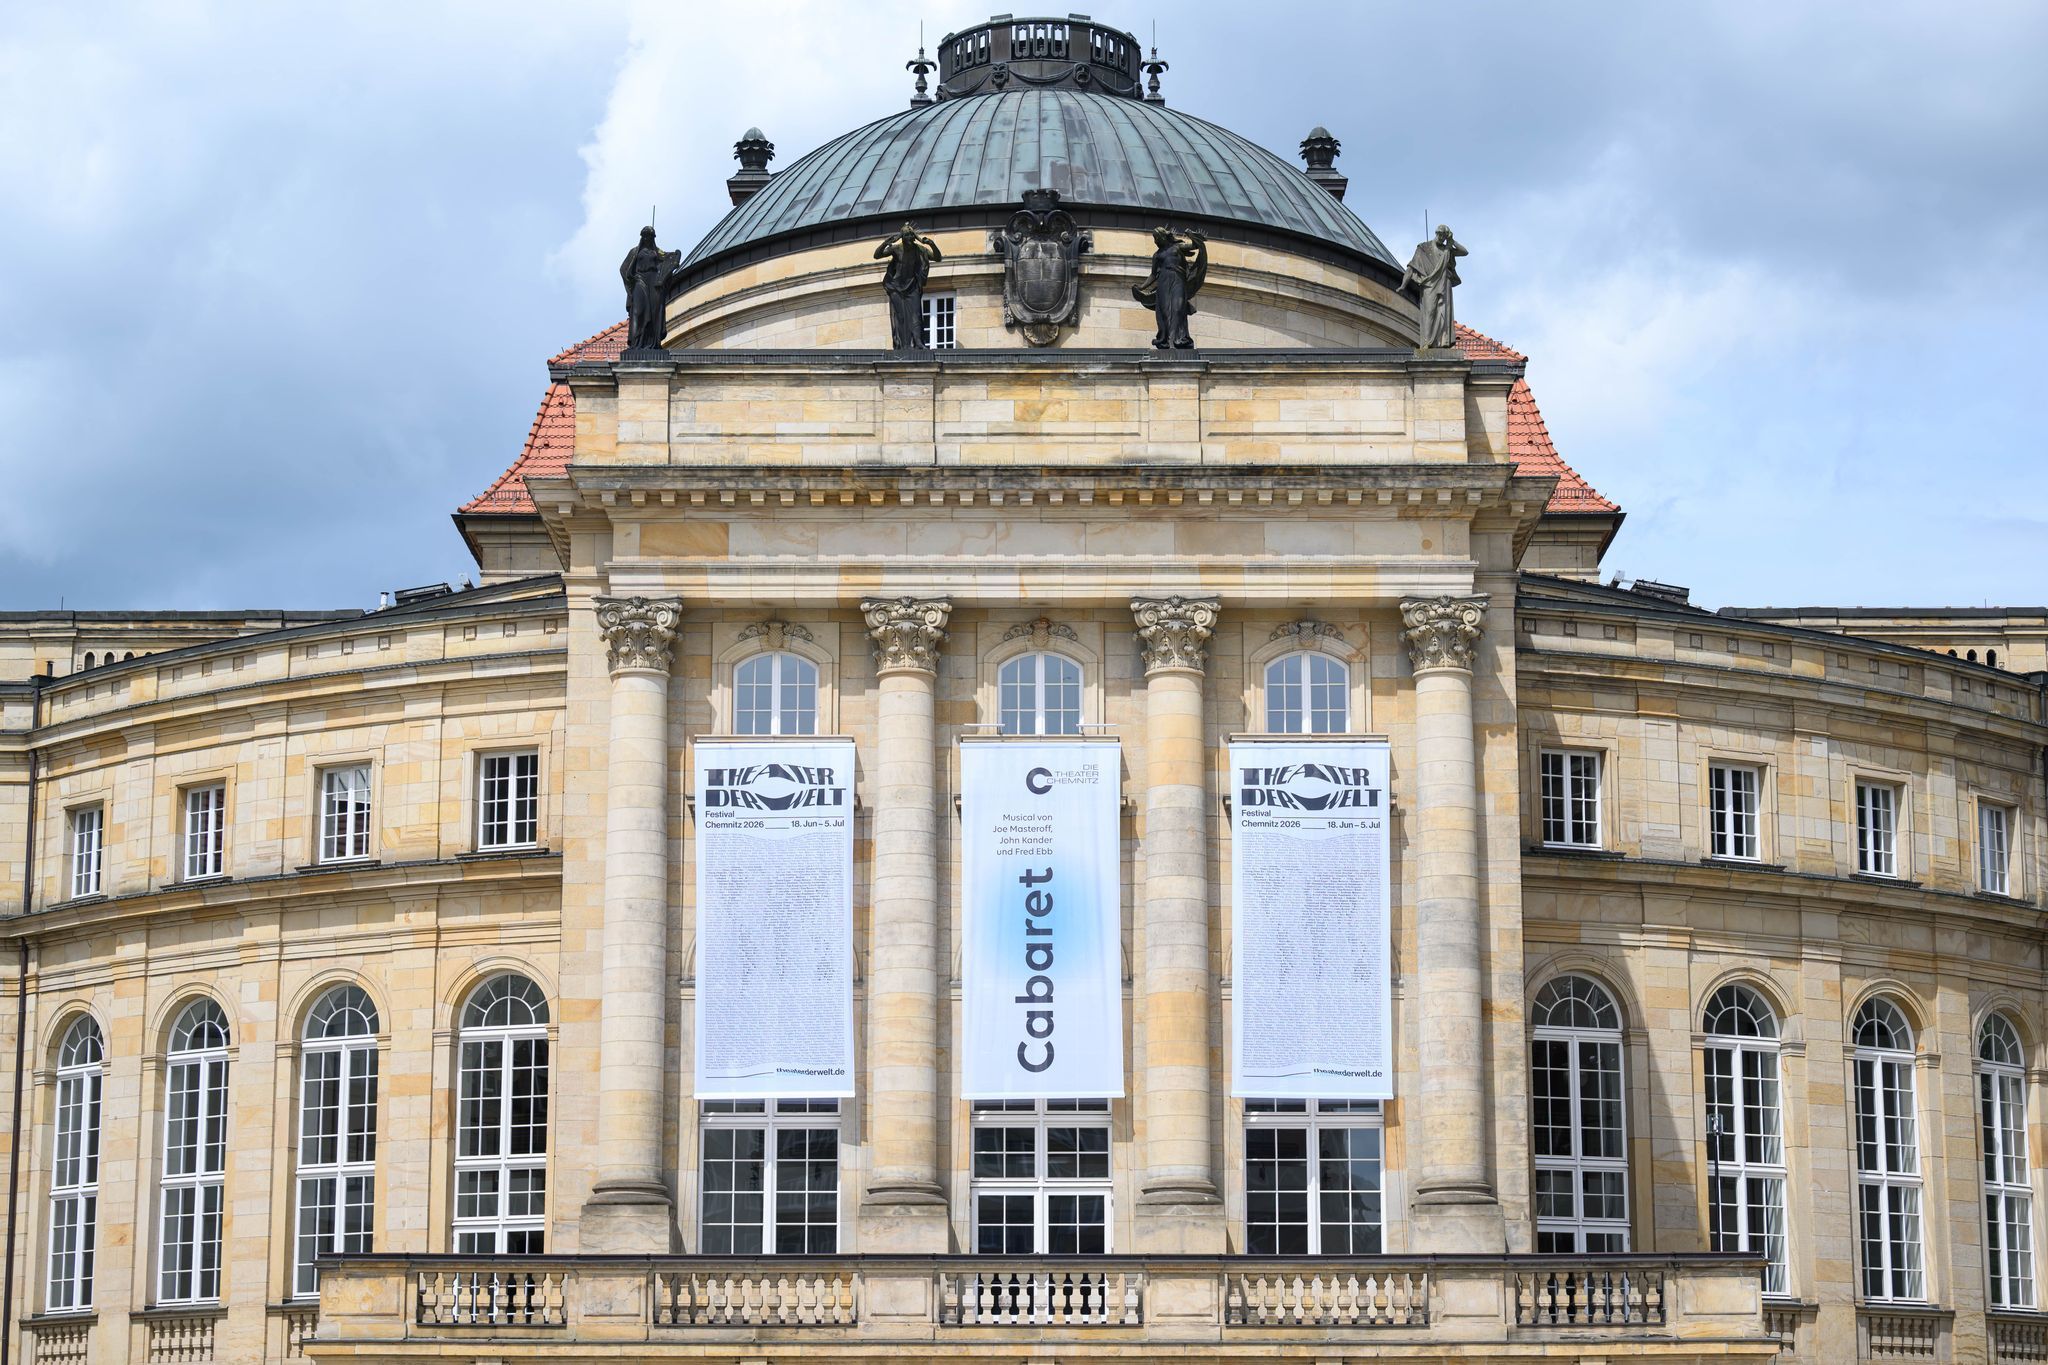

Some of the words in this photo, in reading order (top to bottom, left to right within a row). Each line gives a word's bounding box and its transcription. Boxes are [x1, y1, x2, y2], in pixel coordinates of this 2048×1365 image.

[704, 763, 834, 787] THEATER
[1054, 770, 1099, 778] THEATER
[1240, 763, 1370, 787] THEATER
[1046, 777, 1099, 785] CHEMNITZ
[705, 789, 764, 811] DER
[754, 788, 847, 811] WELT
[1241, 788, 1300, 810] DER
[1291, 789, 1382, 811] WELT
[705, 810, 735, 818] Festival
[1002, 813, 1036, 822] Musical
[1241, 809, 1271, 817] Festival
[705, 820, 743, 829] Chemnitz
[743, 821, 765, 829] 2026
[791, 820, 802, 828] 18.
[802, 819, 818, 828] Jun
[824, 819, 832, 827] 5.
[832, 819, 845, 827] Jul
[993, 825, 1008, 833] Joe
[1009, 824, 1053, 834] Masteroff,
[1241, 819, 1279, 828] Chemnitz
[1280, 820, 1301, 828] 2026
[1327, 821, 1338, 829] 18.
[1339, 821, 1354, 829] Jun
[1360, 821, 1368, 829] 5.
[1368, 821, 1381, 829] Jul
[999, 836, 1020, 845] John
[1021, 836, 1053, 844] Kander
[996, 847, 1013, 856] und
[1015, 848, 1034, 856] Fred
[1036, 847, 1053, 856] Ebb
[1015, 866, 1055, 1073] Cabaret
